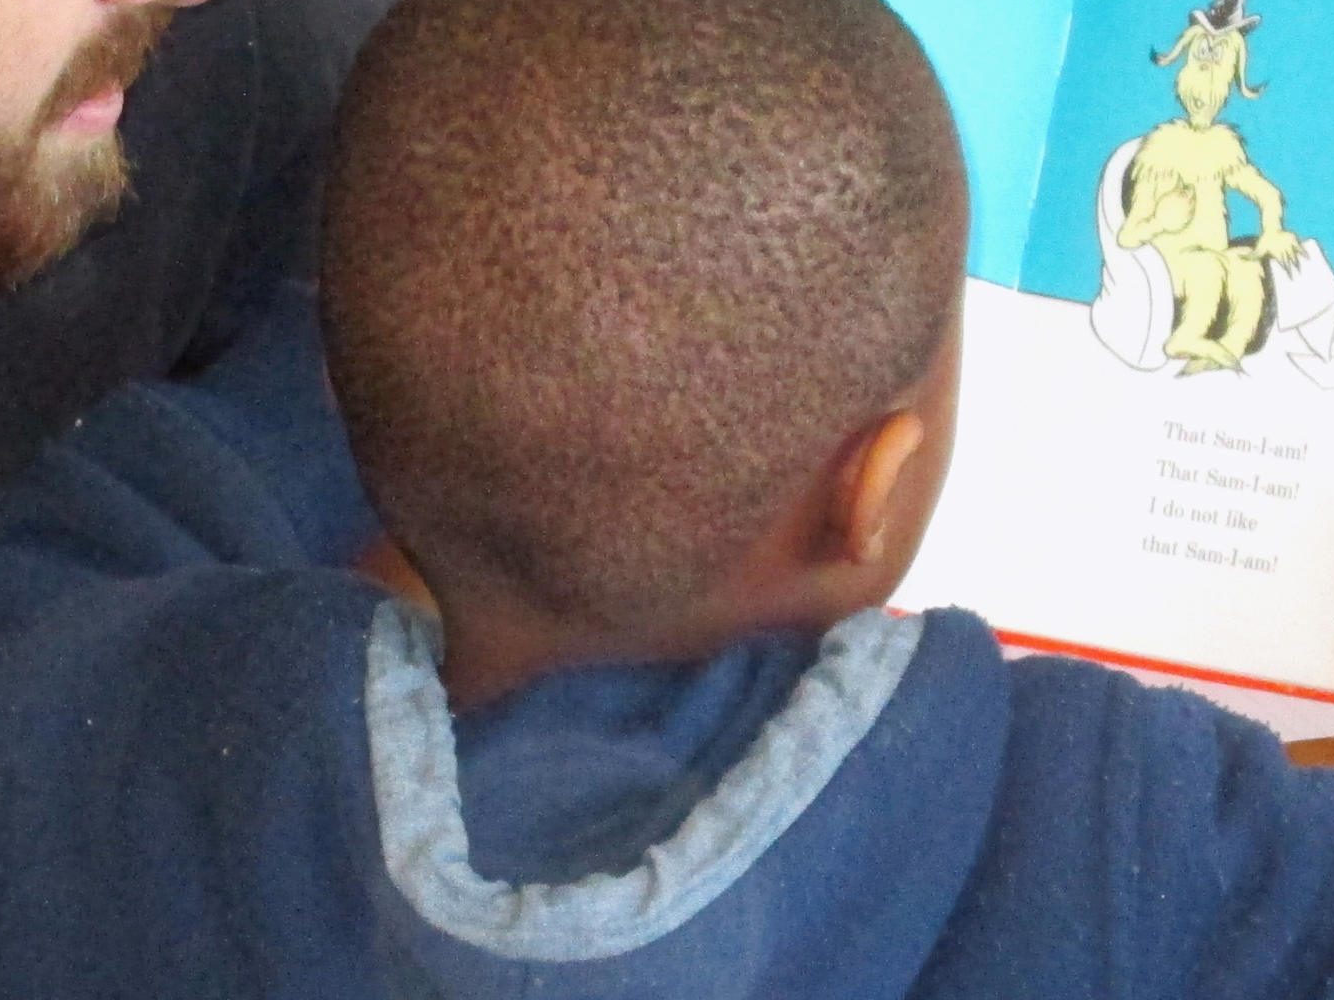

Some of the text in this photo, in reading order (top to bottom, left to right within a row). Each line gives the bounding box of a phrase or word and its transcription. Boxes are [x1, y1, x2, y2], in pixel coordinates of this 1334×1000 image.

[1163, 420, 1308, 461] That Sam-I-am!
[1156, 459, 1300, 501] That Sam-I-am!
[1149, 496, 1258, 532] I do not like
[1141, 535, 1279, 574] that Sam-I-am!
